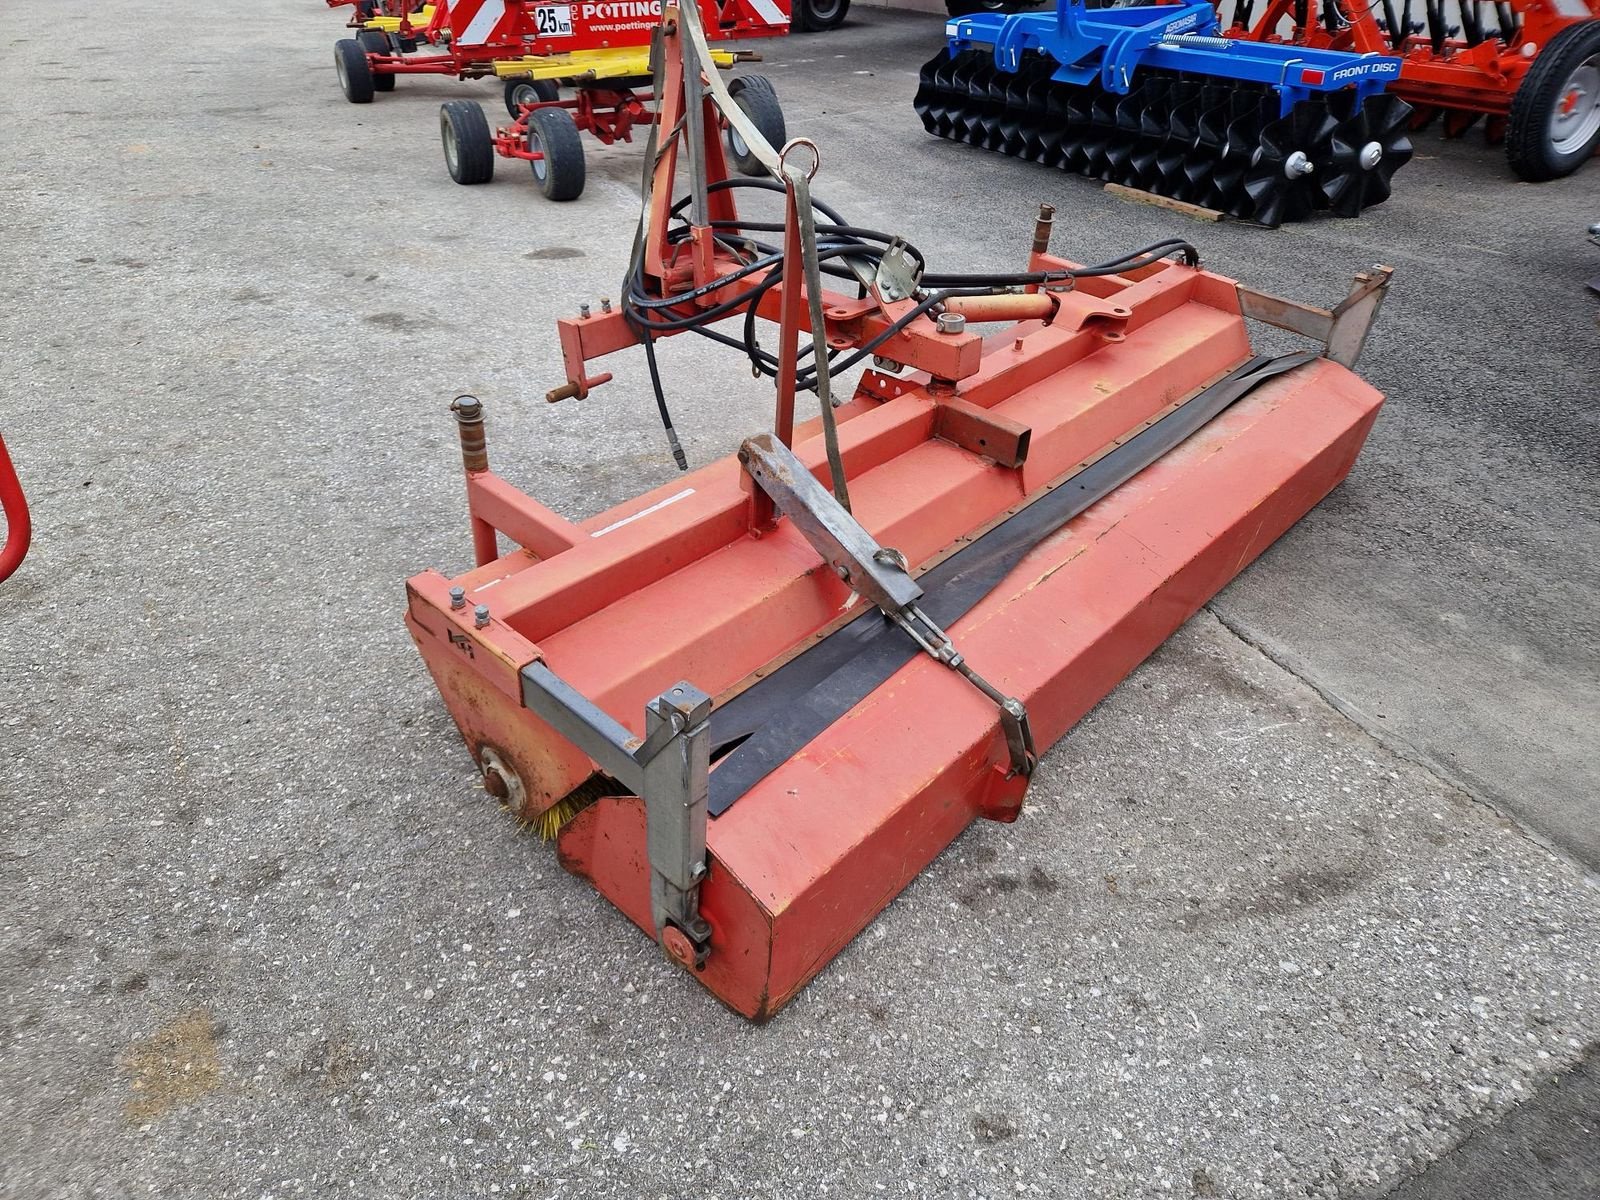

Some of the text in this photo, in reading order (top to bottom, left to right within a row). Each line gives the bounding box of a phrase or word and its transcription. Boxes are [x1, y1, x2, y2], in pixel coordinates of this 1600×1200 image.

[538, 9, 557, 33] 25
[558, 21, 570, 32] km
[1333, 63, 1397, 80] FRONT DISC
